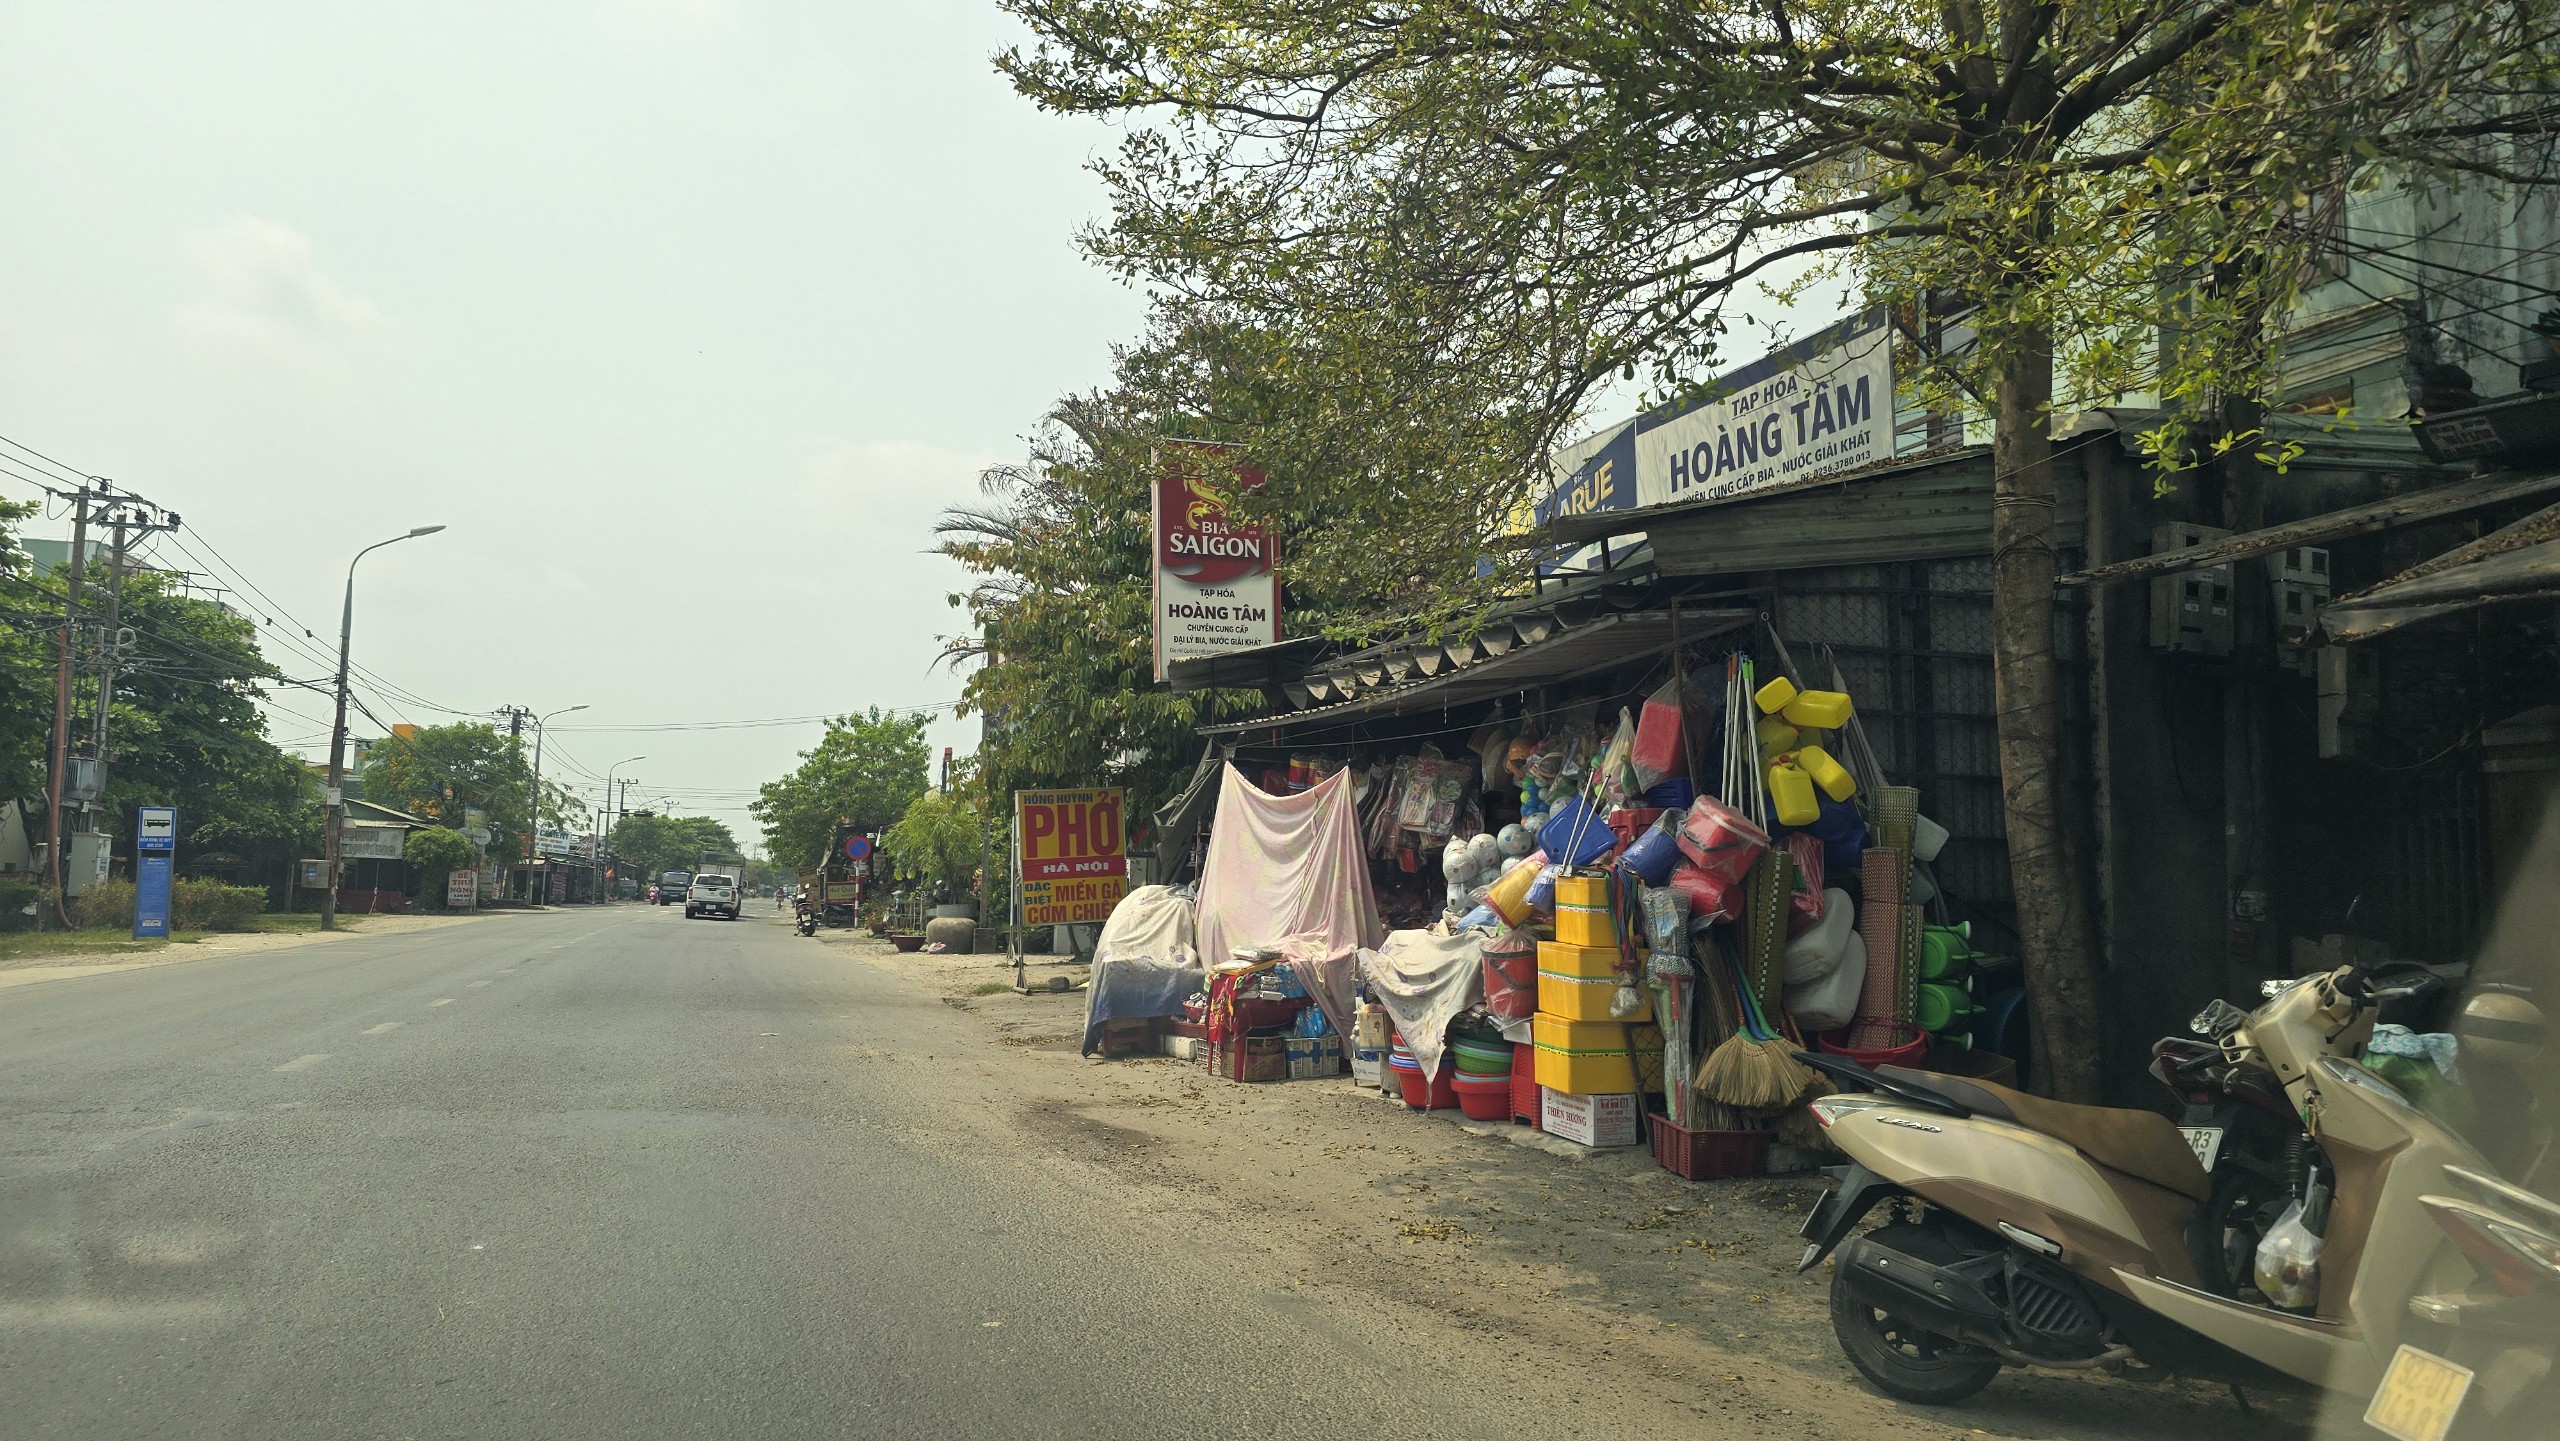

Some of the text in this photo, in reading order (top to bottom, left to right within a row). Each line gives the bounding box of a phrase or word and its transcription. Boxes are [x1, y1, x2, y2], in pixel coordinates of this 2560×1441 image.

[1732, 375, 1798, 417] TẠP HÓA
[1670, 375, 1871, 493] HOÀNG TÂM
[1708, 481, 1734, 500] CUNG
[1736, 470, 1755, 490] CẤP
[1757, 467, 1775, 483] BIA
[1782, 452, 1812, 474] NƯỚC
[1815, 442, 1837, 462] GIẢI
[1841, 430, 1871, 453] KHÁT
[1856, 450, 1871, 463] 013
[1202, 521, 1229, 534] BIA
[1170, 533, 1260, 558] SAIGON
[1200, 588, 1235, 599] TẠP HÓA
[1168, 602, 1266, 622] HOÀNG TÂM
[1187, 622, 1249, 634] CHUYÊN CUNG CẤP
[1174, 636, 1185, 645] ĐẠI
[1186, 635, 1194, 643] LÝ
[1195, 636, 1208, 645] BIA,
[1209, 636, 1230, 645] NƯỚC
[1245, 637, 1262, 647] KHÁT
[1025, 791, 1120, 859] PHỞ
[1043, 860, 1109, 874] HÀ NỘI
[1025, 893, 1053, 906] BIỆT
[1055, 879, 1097, 902] MIẾN
[1101, 879, 1122, 899] GÀ
[1027, 904, 1068, 925] CƠM
